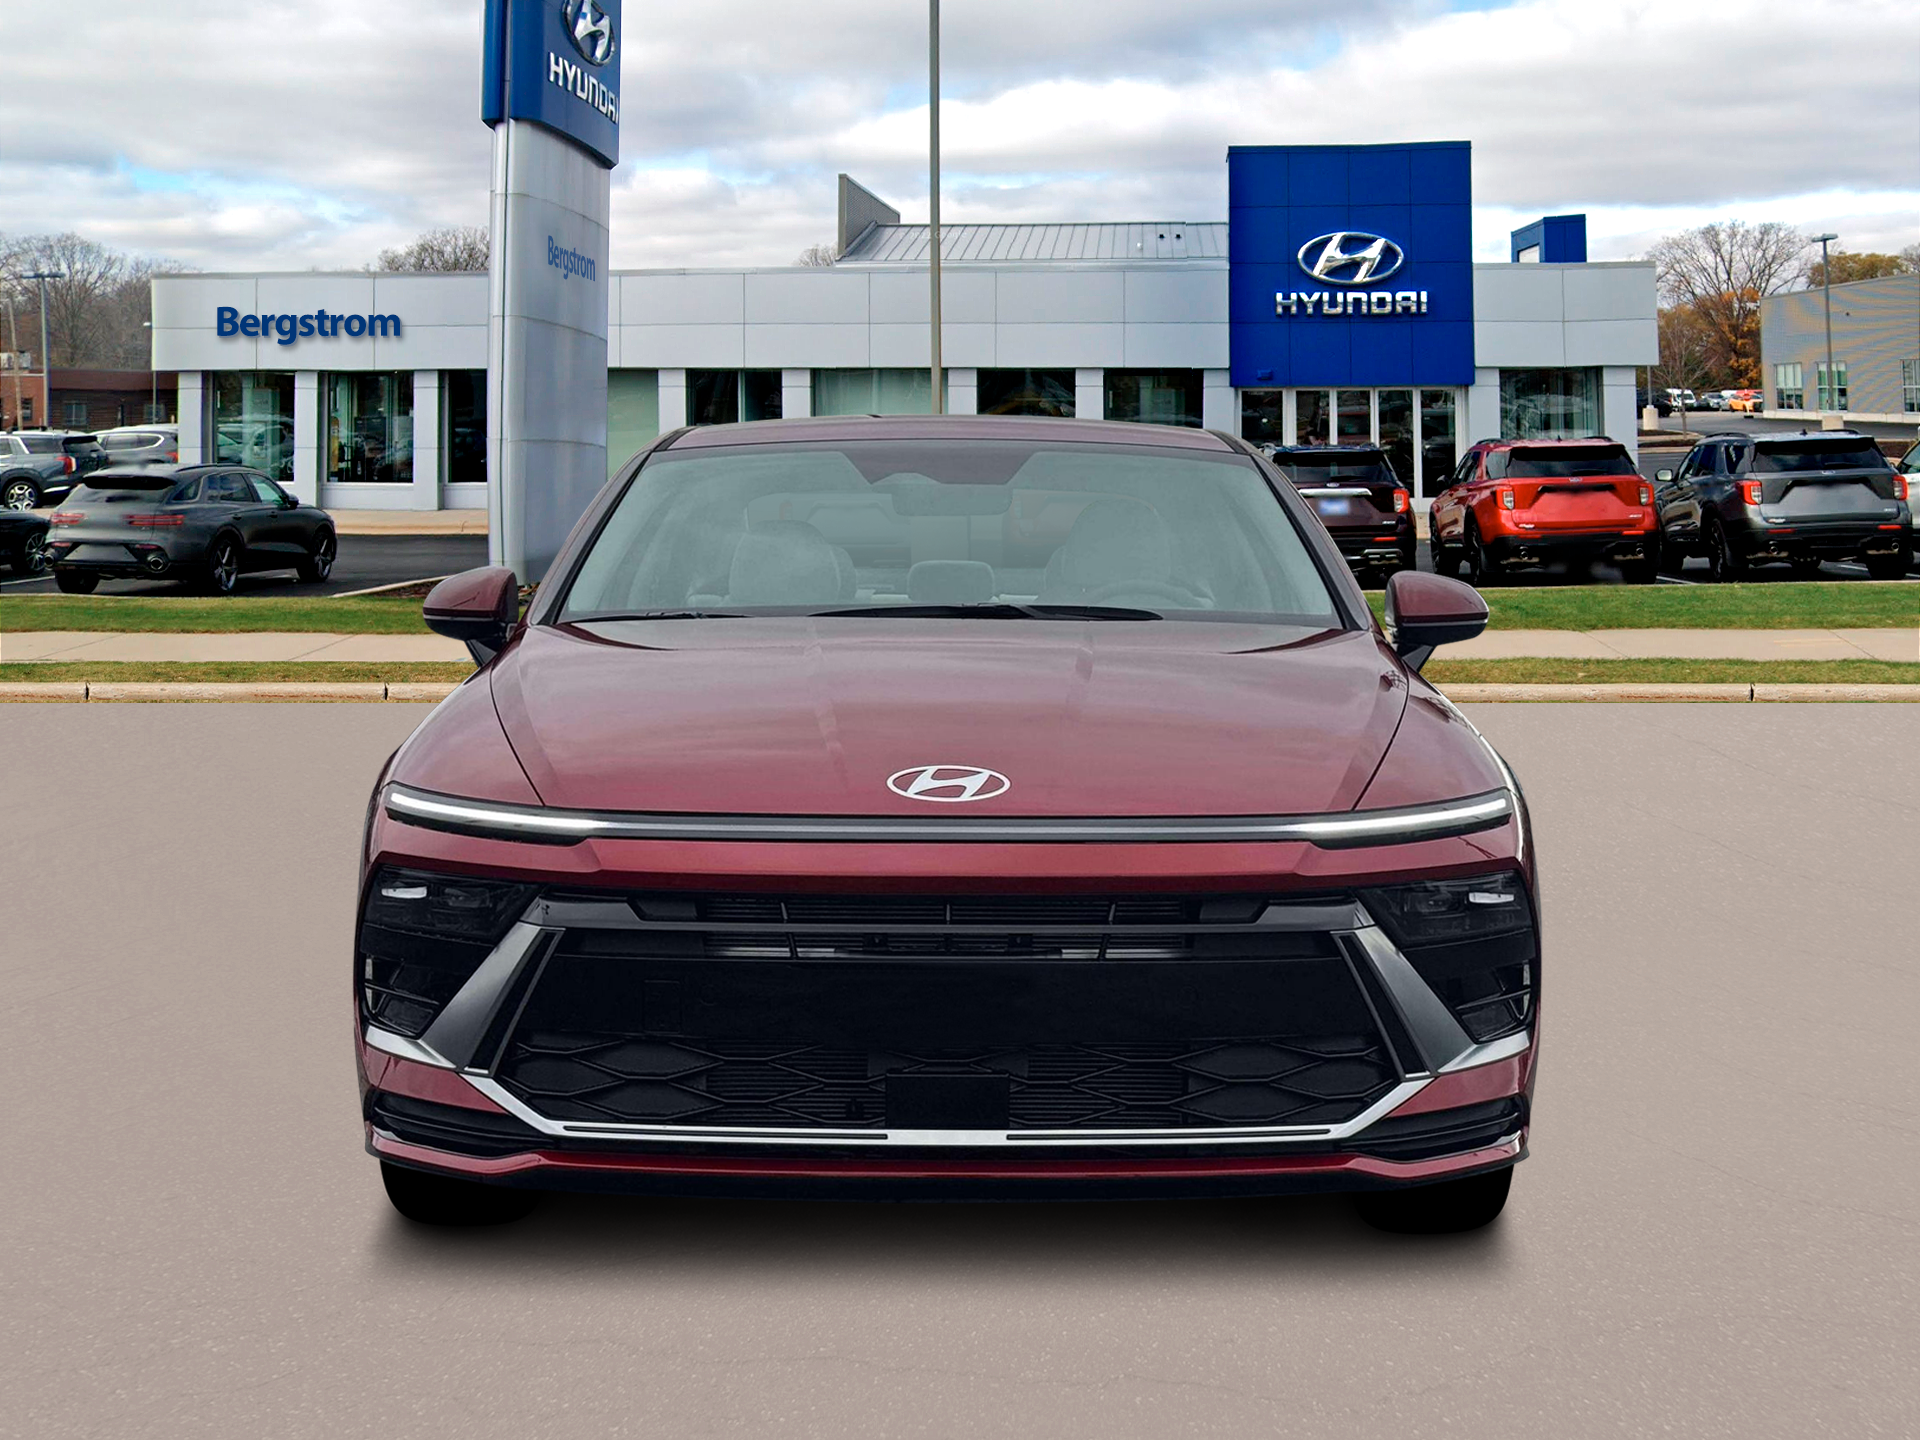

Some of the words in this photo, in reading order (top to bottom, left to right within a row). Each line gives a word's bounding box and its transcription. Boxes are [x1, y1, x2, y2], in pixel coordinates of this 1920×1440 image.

[548, 52, 618, 123] HYUNDAI
[547, 236, 595, 281] Bergstrom
[1275, 291, 1427, 315] HYUNDAI
[216, 306, 401, 346] Bergstrom
